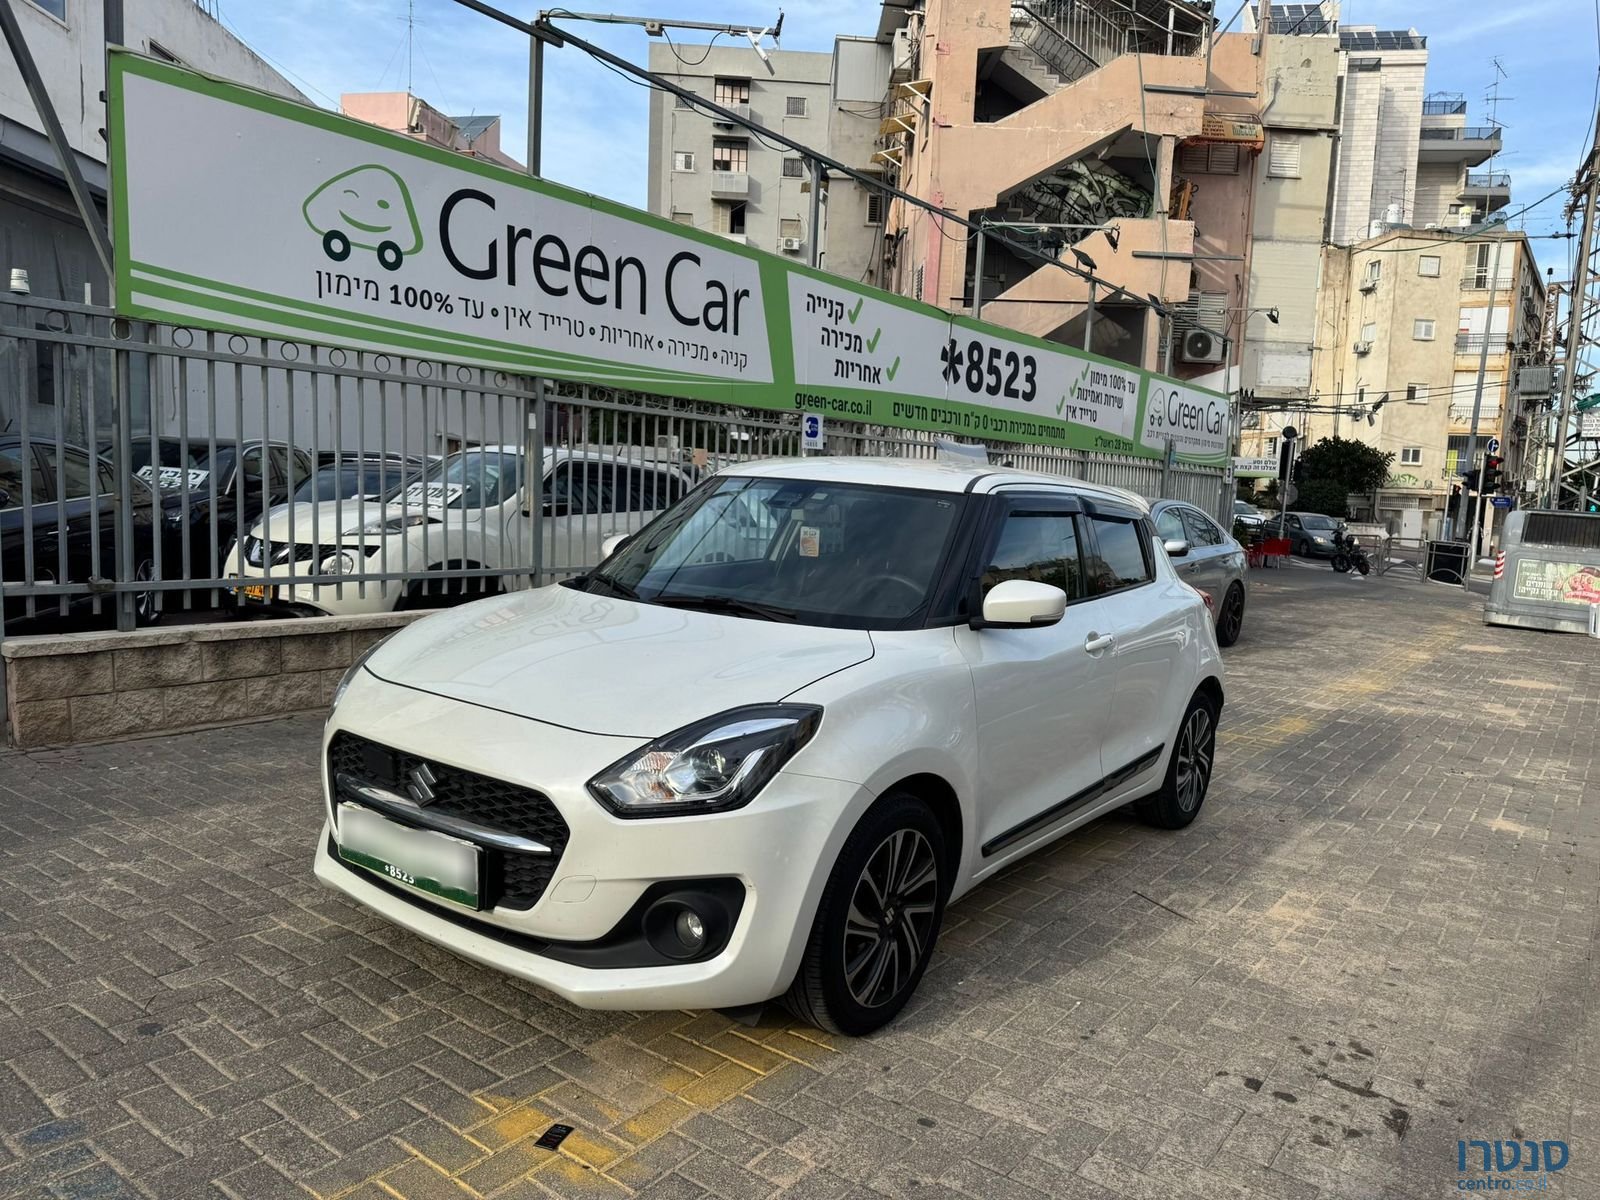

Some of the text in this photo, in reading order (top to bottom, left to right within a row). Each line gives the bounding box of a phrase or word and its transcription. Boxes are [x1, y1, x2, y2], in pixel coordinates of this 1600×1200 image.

[439, 188, 750, 336] Green Car
[316, 270, 748, 372] קניה מכירה אחריות טרייד אין עד 100% מימון
[806, 293, 845, 325] קנייה
[821, 326, 863, 353] מכירה
[834, 358, 882, 384] אחריות
[1090, 370, 1136, 394] עד 100% מימון
[794, 392, 872, 416] green-car.co.il
[893, 402, 928, 421] חדשים
[1104, 393, 1124, 409] שירות
[931, 408, 961, 426] ורכבים
[990, 417, 1008, 433] רכבי
[1066, 404, 1098, 423] טרייד אין
[1168, 391, 1225, 436] Green Car
[1009, 421, 1037, 436] במכירת
[1038, 424, 1066, 440] מתמחים
